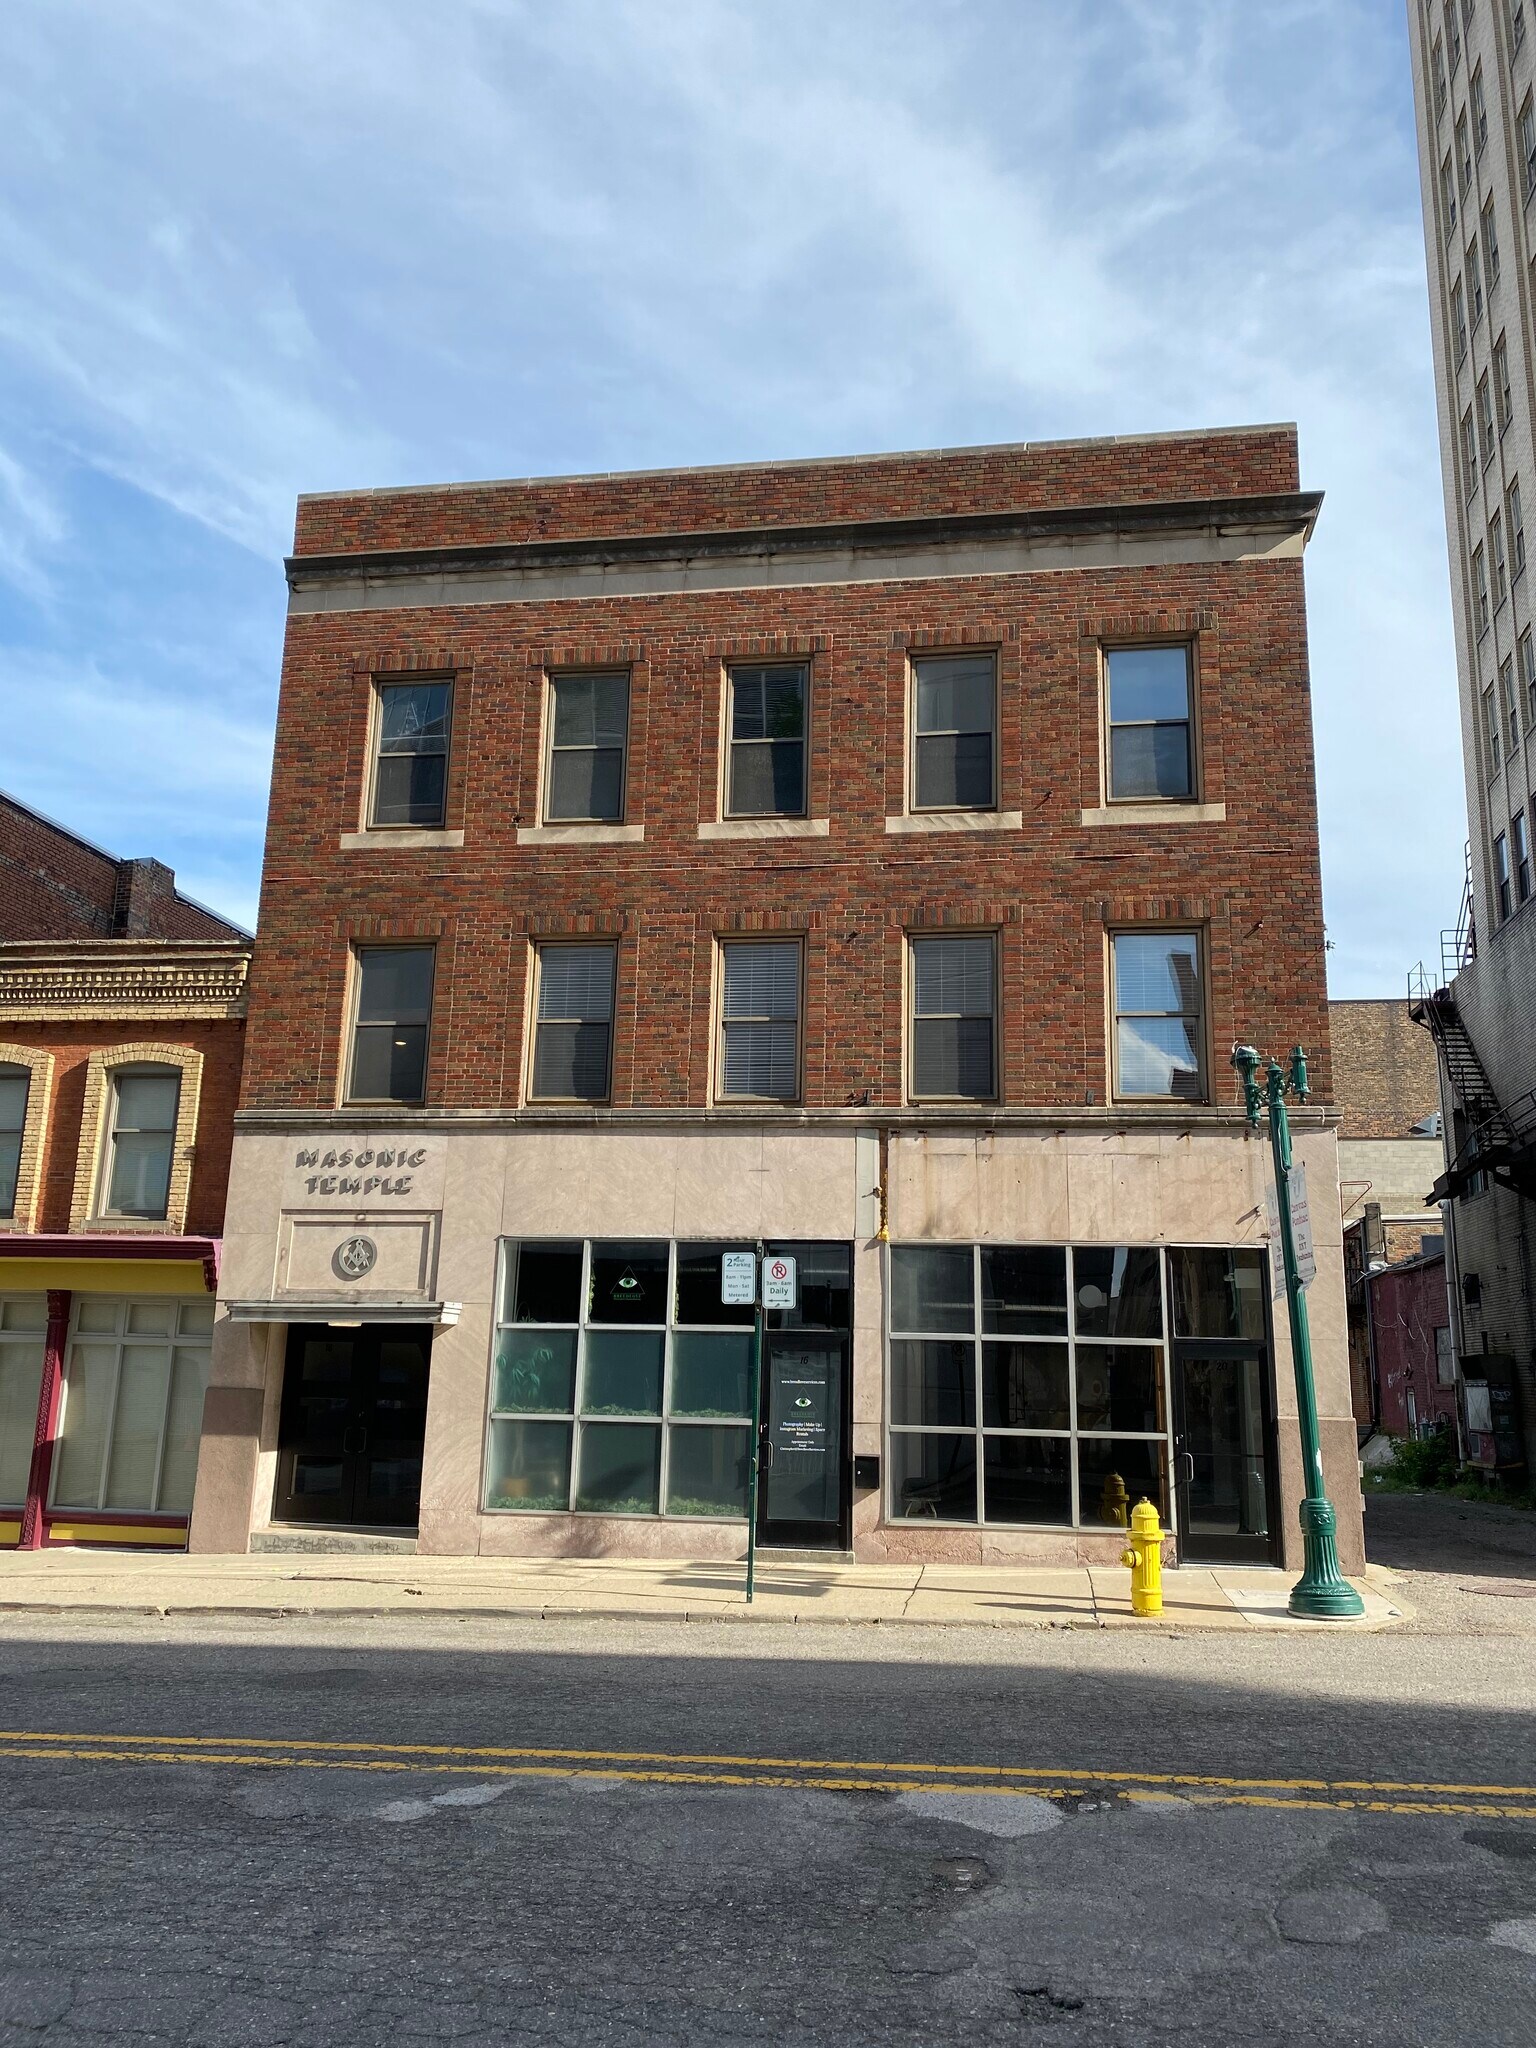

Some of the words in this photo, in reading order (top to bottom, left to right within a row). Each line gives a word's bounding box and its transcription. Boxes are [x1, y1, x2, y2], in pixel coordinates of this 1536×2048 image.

[296, 1149, 427, 1168] MASONIC
[305, 1175, 414, 1195] TEMPLE
[727, 1258, 732, 1267] 2
[800, 1356, 808, 1364] 16
